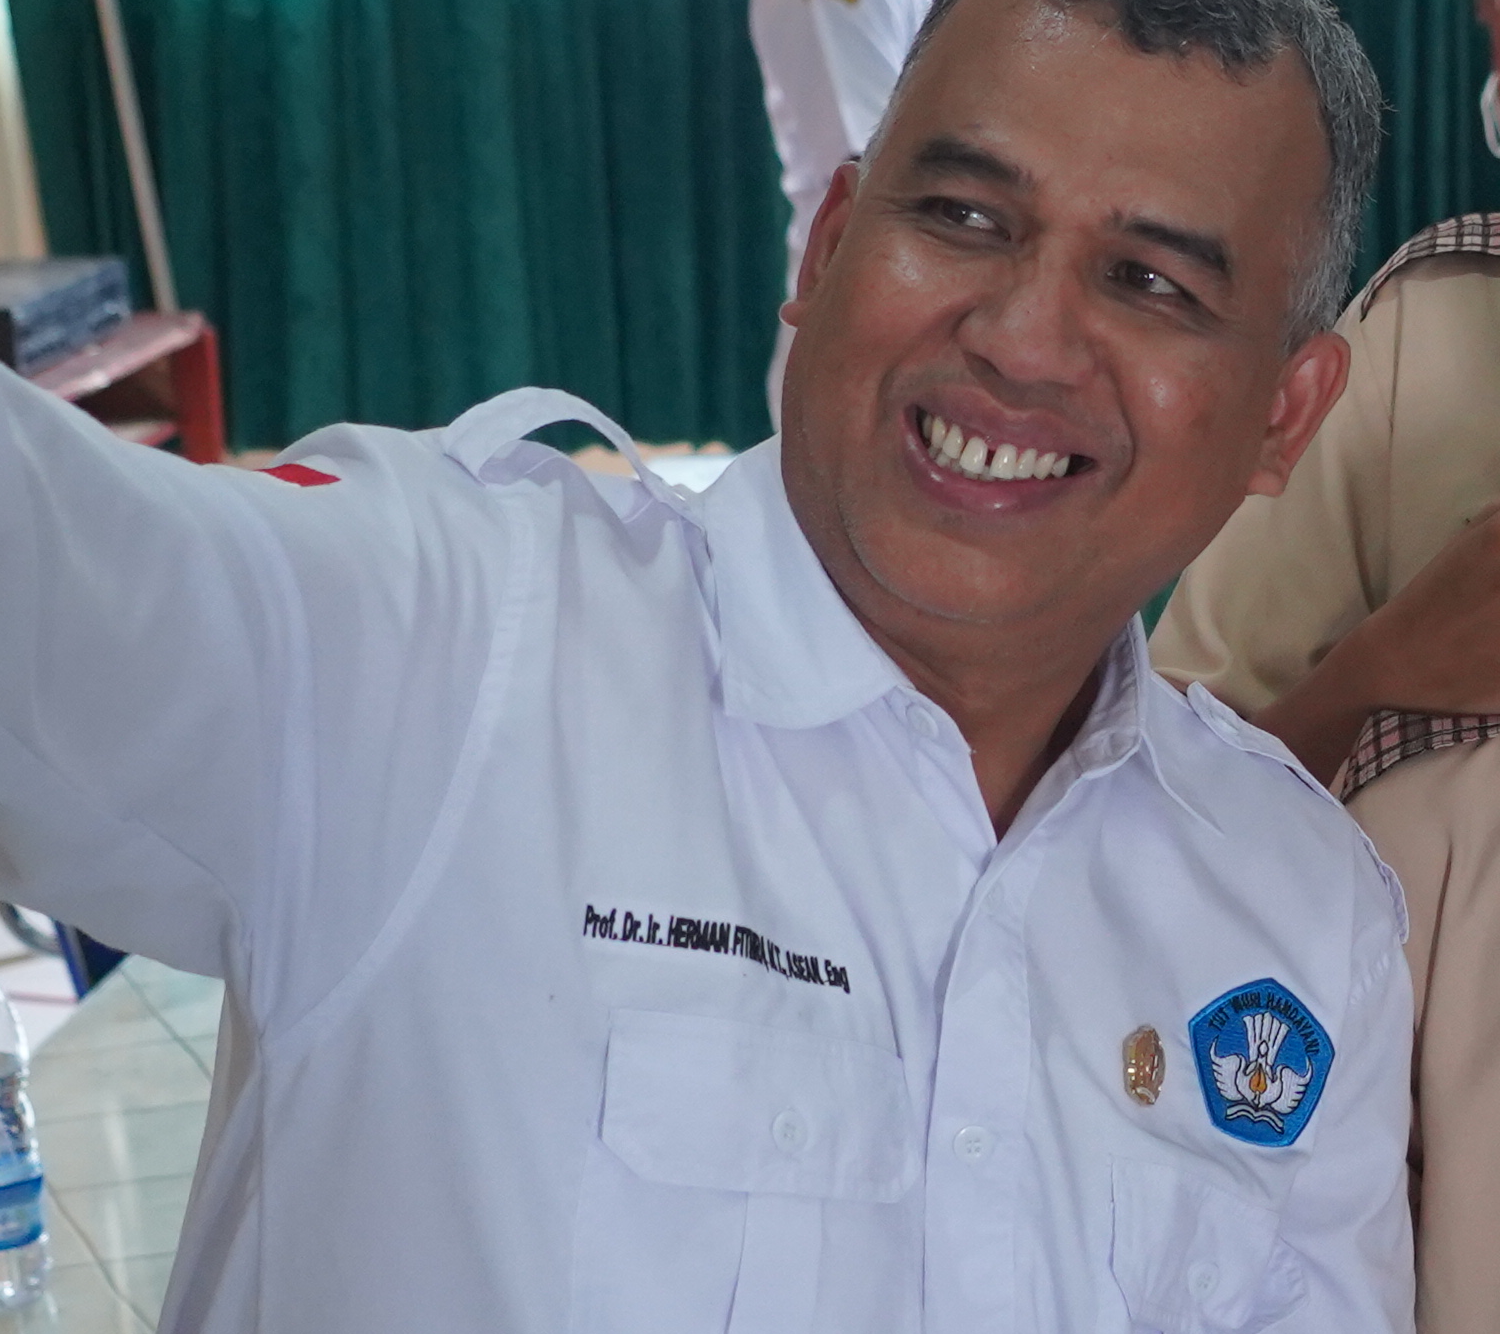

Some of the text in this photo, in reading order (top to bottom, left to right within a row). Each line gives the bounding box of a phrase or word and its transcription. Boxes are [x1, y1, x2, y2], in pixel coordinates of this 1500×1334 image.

[583, 904, 618, 940] Prof.
[622, 910, 644, 943] Dr.
[666, 915, 730, 954] HERMAN
[1207, 991, 1321, 1055] TUT WURI HANDAYANI
